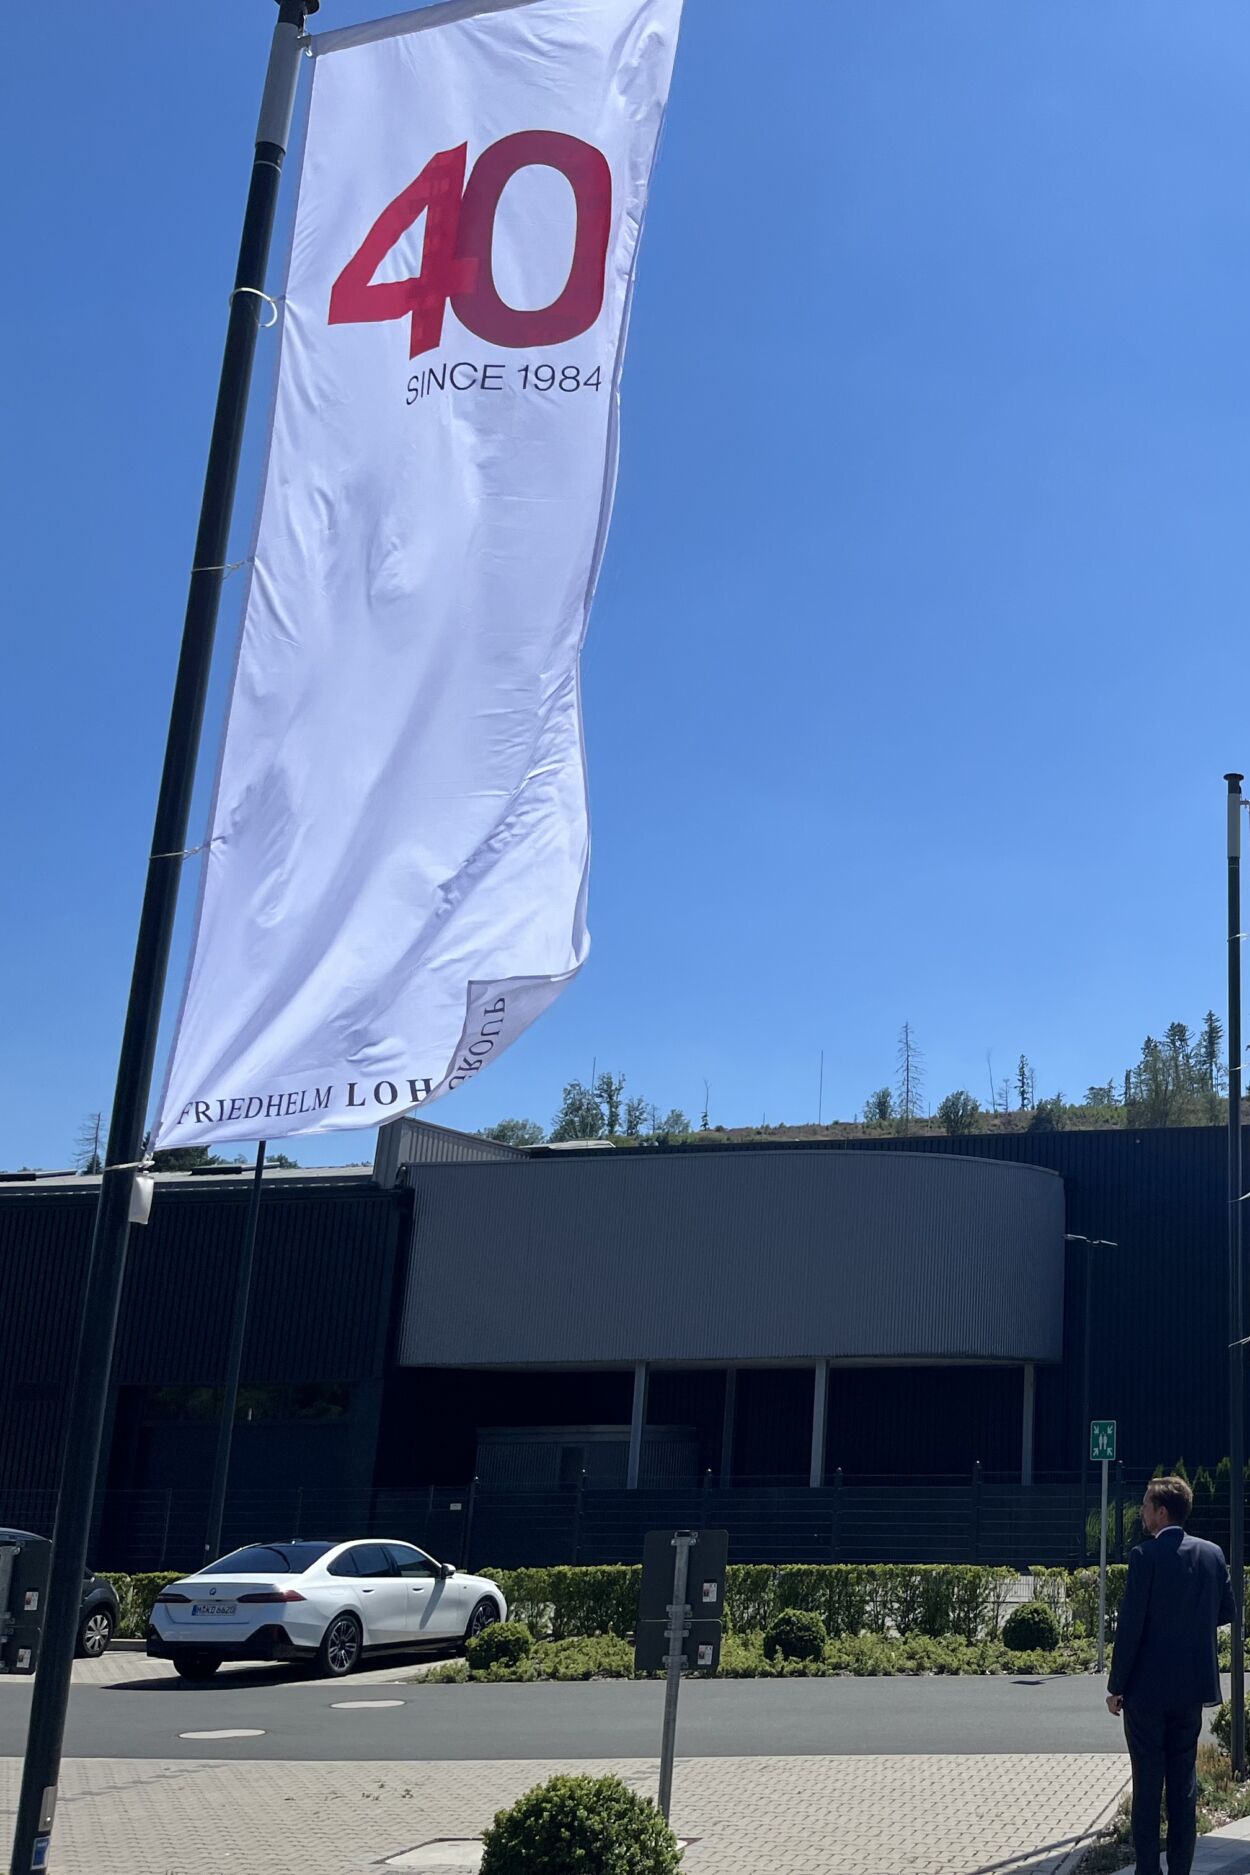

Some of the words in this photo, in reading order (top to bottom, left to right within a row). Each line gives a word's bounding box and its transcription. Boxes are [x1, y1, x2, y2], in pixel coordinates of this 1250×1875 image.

[328, 129, 612, 360] 40
[406, 362, 506, 406] SINCE
[517, 363, 603, 393] 1984
[177, 1085, 335, 1126] FRIEDHELM
[345, 1077, 434, 1108] LOH
